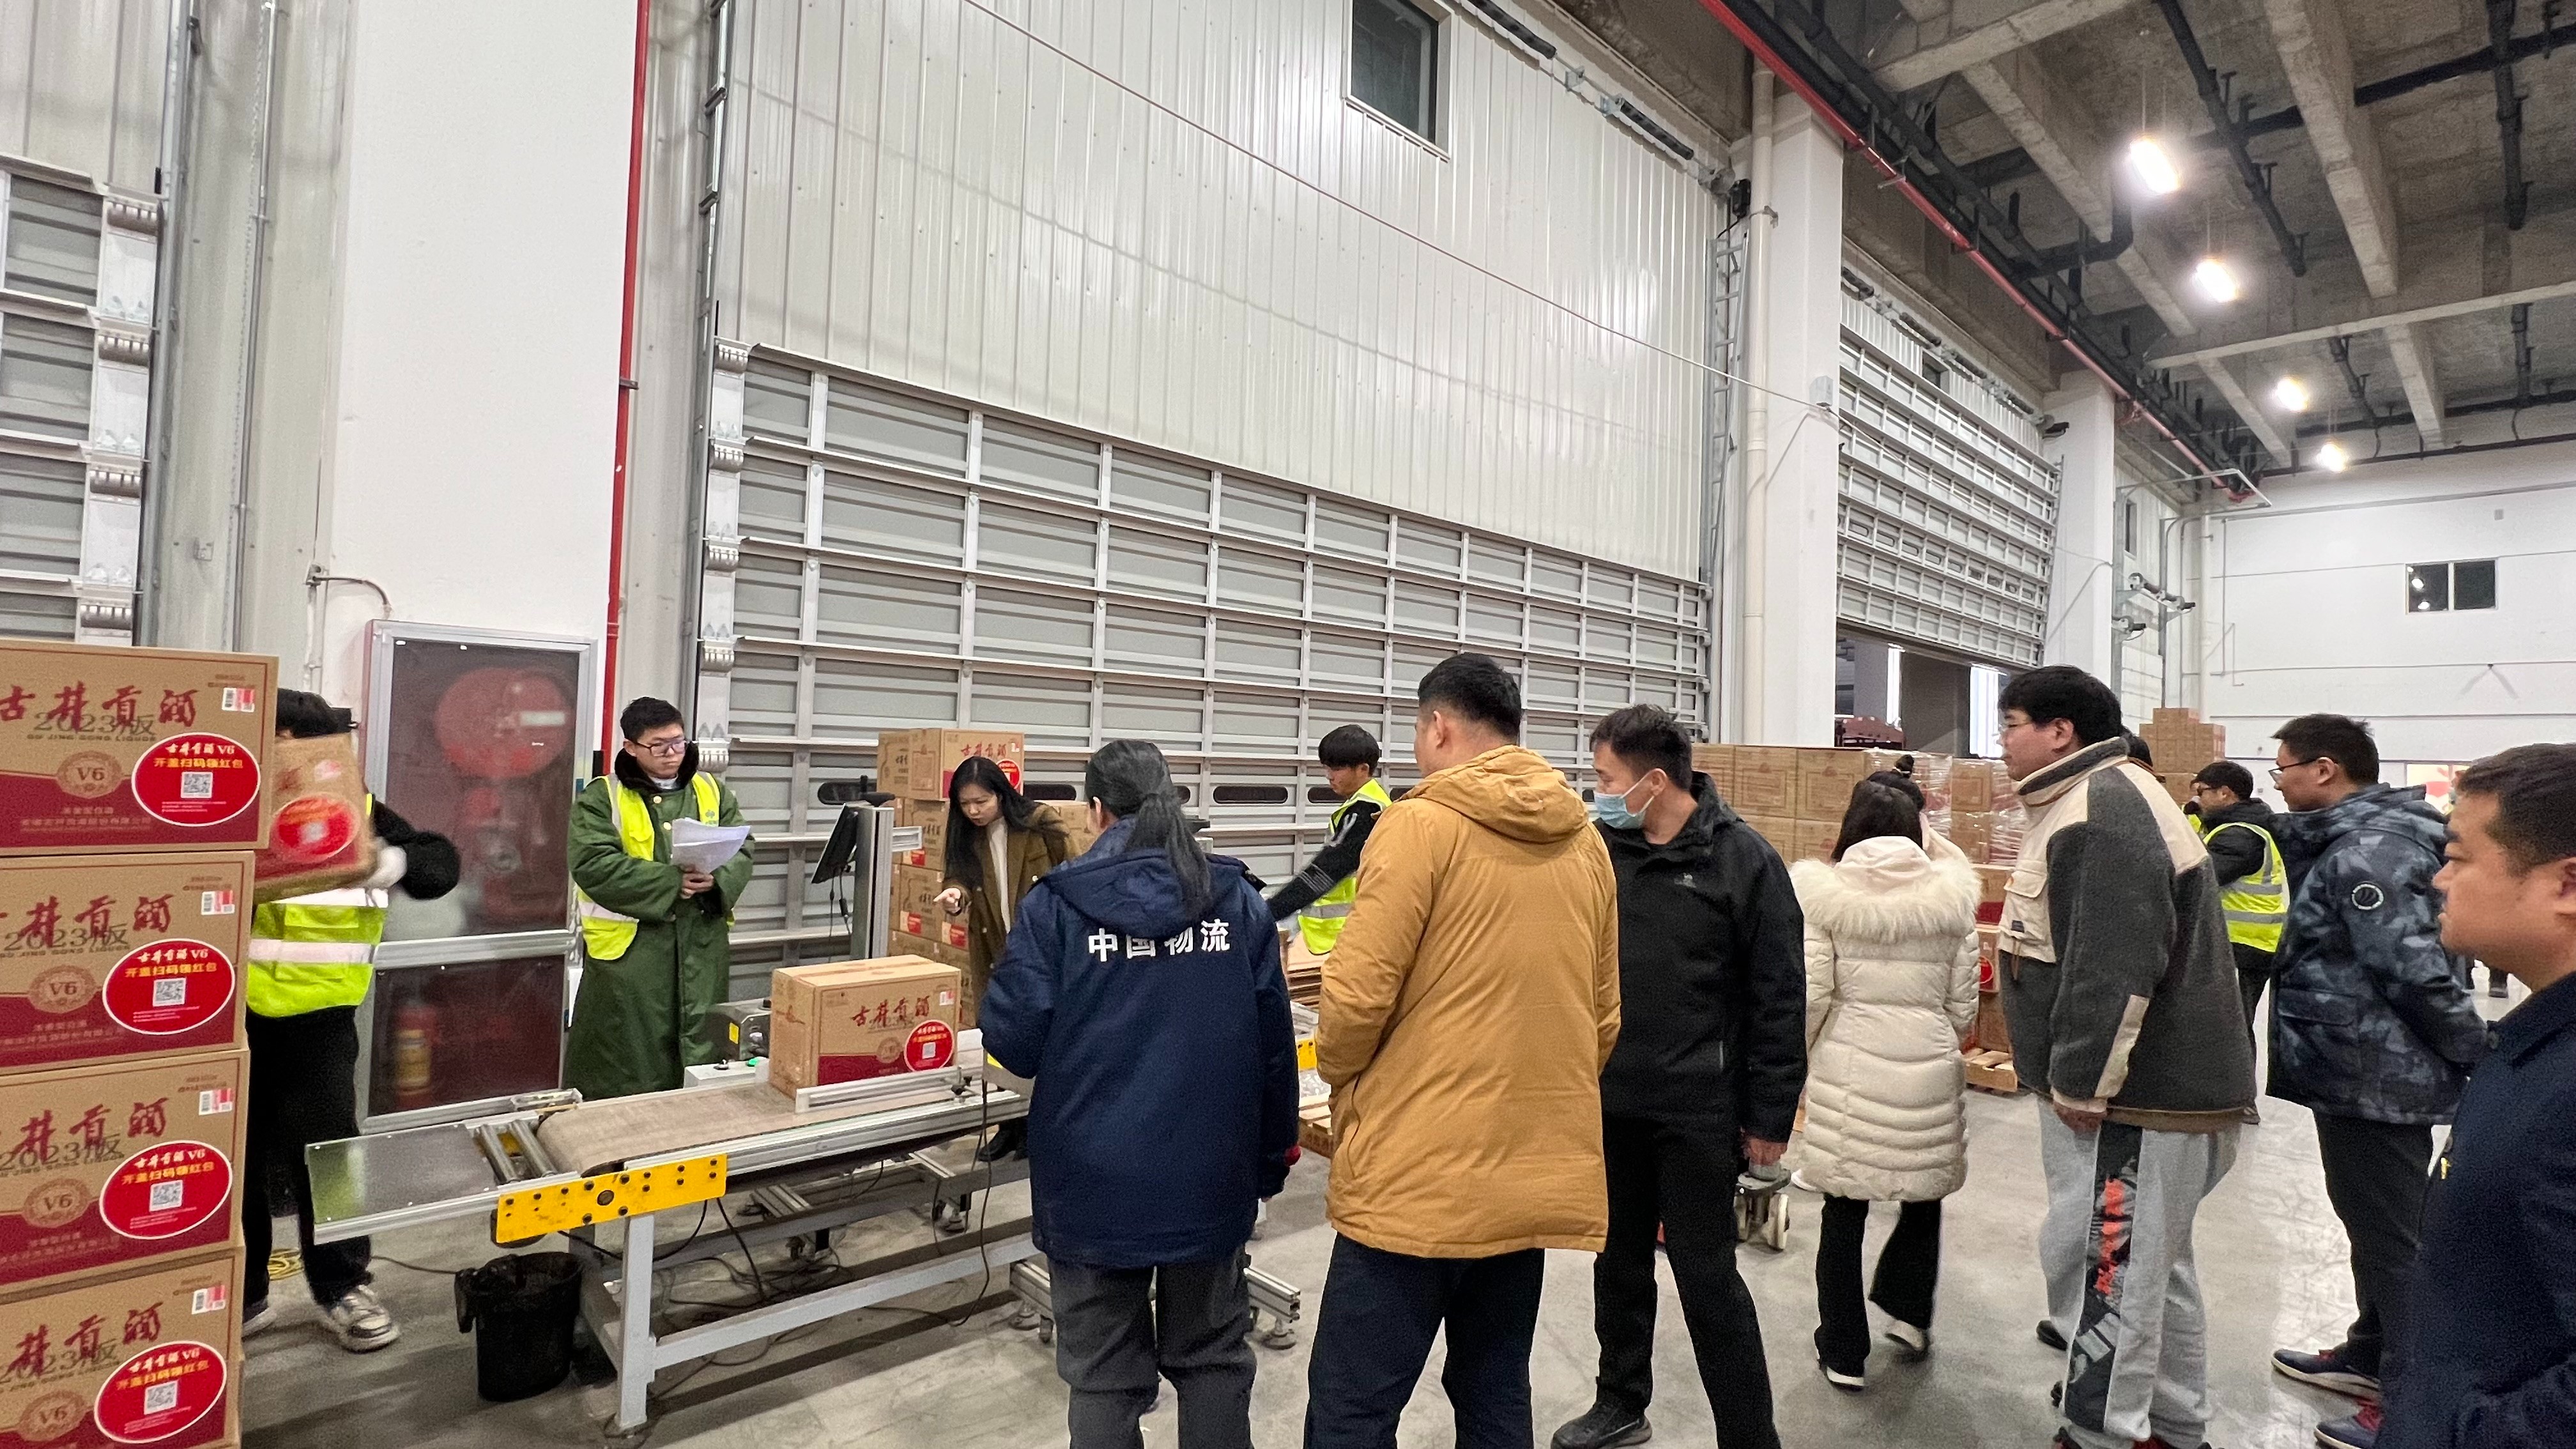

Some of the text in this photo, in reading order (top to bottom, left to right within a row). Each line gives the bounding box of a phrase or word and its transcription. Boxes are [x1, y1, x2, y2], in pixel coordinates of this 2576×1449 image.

[77, 767, 105, 781] V6
[1088, 918, 1230, 962] 中国物流
[50, 981, 77, 995] V6
[43, 1193, 73, 1211] V6
